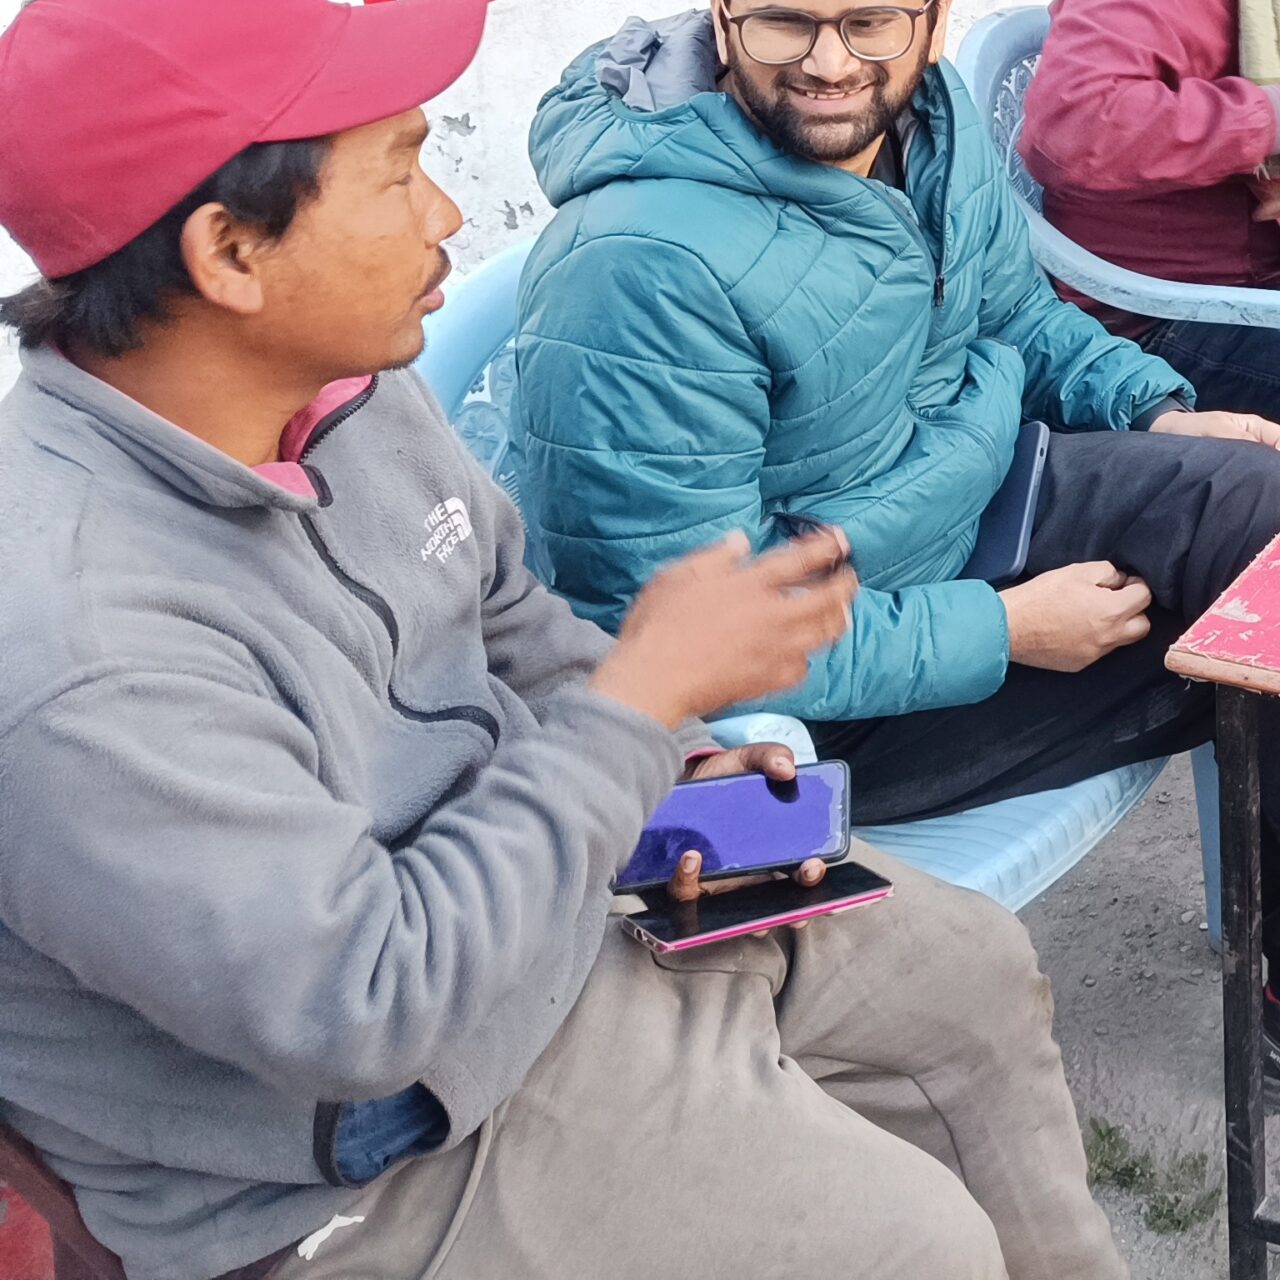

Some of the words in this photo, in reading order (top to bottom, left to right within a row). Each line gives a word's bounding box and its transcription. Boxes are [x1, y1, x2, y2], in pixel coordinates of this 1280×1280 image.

[424, 503, 449, 532] THE
[420, 517, 455, 561] NORTH
[435, 531, 459, 563] FACE
